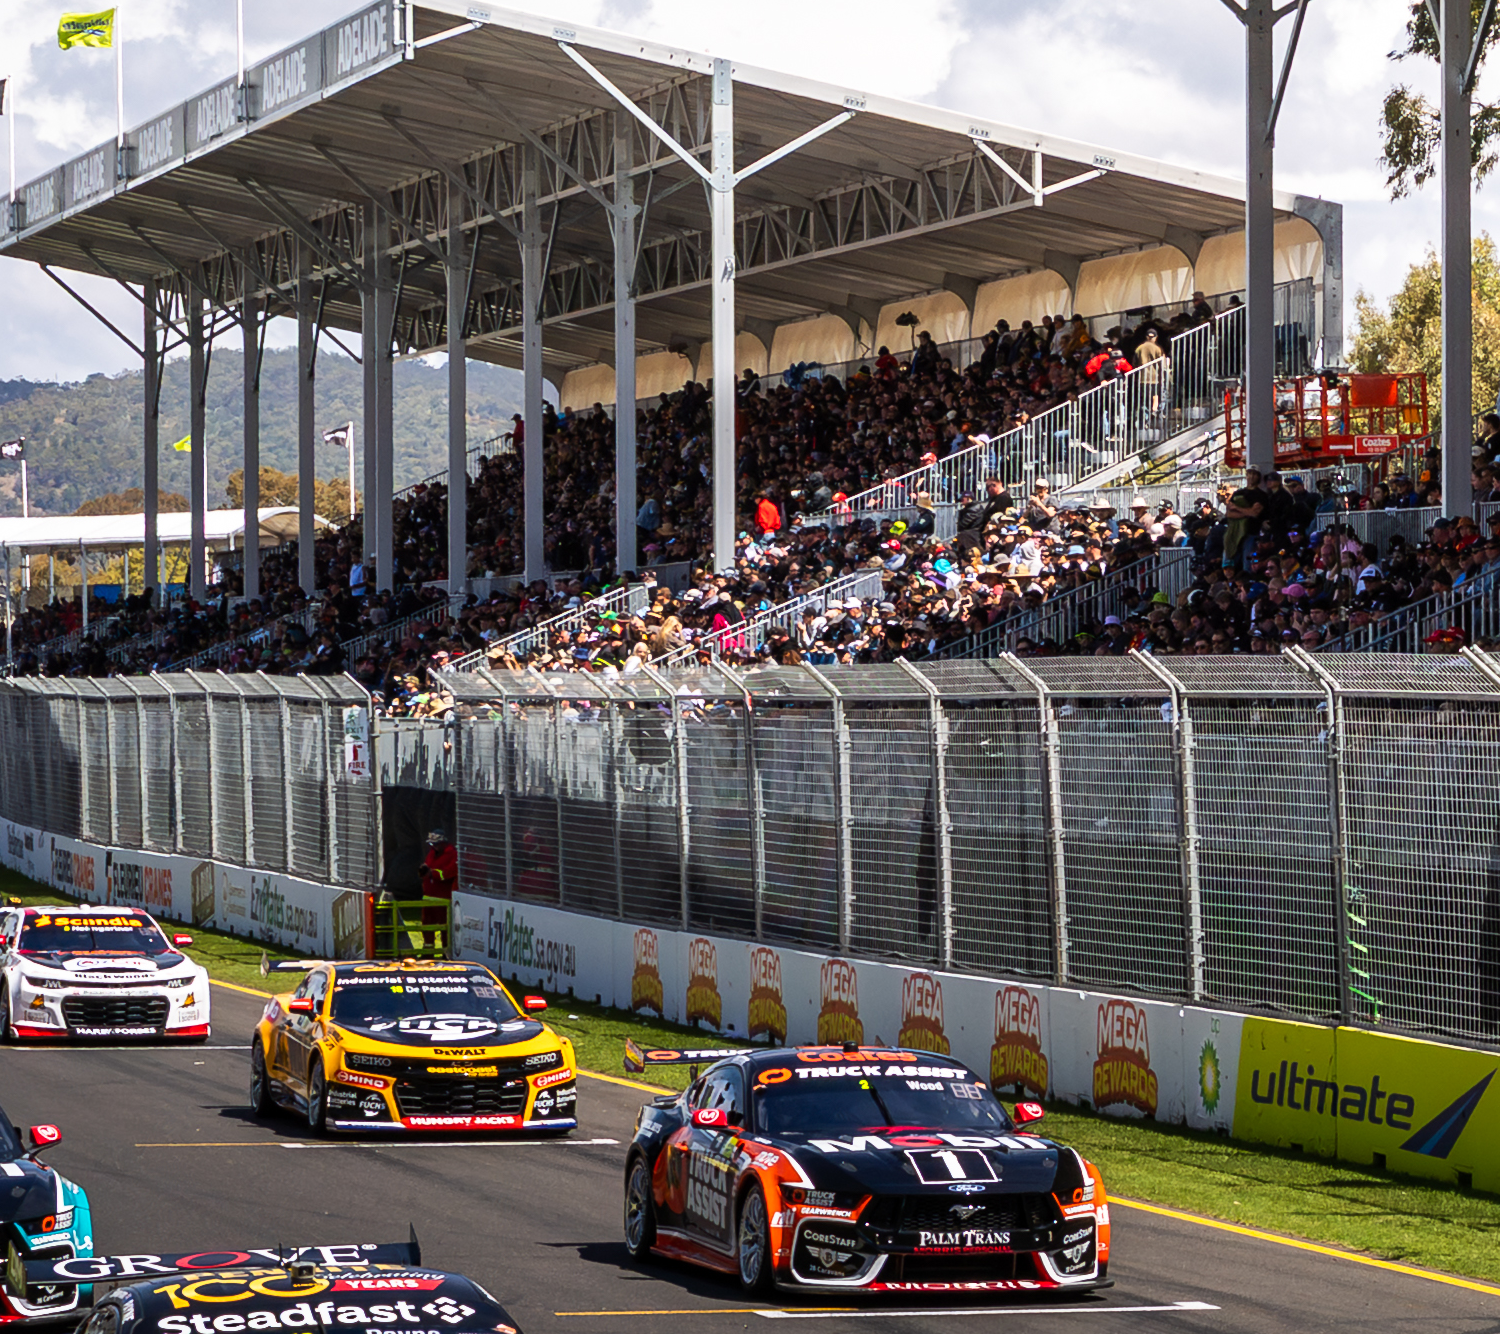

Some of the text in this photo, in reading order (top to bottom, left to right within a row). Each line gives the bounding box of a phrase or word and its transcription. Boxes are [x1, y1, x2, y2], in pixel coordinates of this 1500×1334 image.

[337, 5, 387, 74] ADELAIDE
[263, 47, 306, 111] ADELAIDE
[197, 83, 234, 142] ADELAIDE
[138, 116, 173, 171] ADELAIDE
[1362, 437, 1391, 447] Coates
[346, 726, 364, 734] EXIT
[144, 866, 172, 907] CRANES
[488, 906, 576, 984] EzyPlates.sa.gov.au
[634, 929, 658, 967] MEGA
[689, 938, 717, 985] MEGA
[337, 975, 468, 985] Industrial Batteries
[751, 947, 782, 998] MEGA
[405, 985, 468, 995] De Pasquale
[821, 959, 858, 1014] MEGA
[903, 973, 944, 1028] MEGA
[996, 986, 1041, 1043] MEGA
[1098, 1000, 1149, 1063] MEGA
[1211, 1018, 1220, 1034] bp
[352, 1055, 392, 1067] SEIKO
[525, 1053, 557, 1066] SEIKO
[797, 1049, 919, 1063] Coates
[795, 1065, 968, 1080] TRUCK ASSIST
[991, 1045, 1048, 1093] REWARDS
[349, 1074, 385, 1087] HINO
[906, 1080, 945, 1092] Wood
[1095, 1059, 1157, 1113] REWARDS
[359, 1101, 386, 1110] FUCHS
[534, 1099, 554, 1108] FUCHS
[1250, 1061, 1415, 1130] ultimate
[410, 1116, 515, 1126] HUNGRY JACKS
[807, 1133, 1048, 1154] Mobil
[933, 1151, 968, 1179] 1
[804, 1198, 835, 1207] ASSIST
[807, 1190, 835, 1200] TRUCK
[800, 1207, 852, 1218] GEARWRENCH
[920, 1230, 1011, 1246] PALM TRANS
[53, 1244, 371, 1278] GROVE
[154, 1274, 330, 1308] 100
[346, 1279, 420, 1290] YEARS
